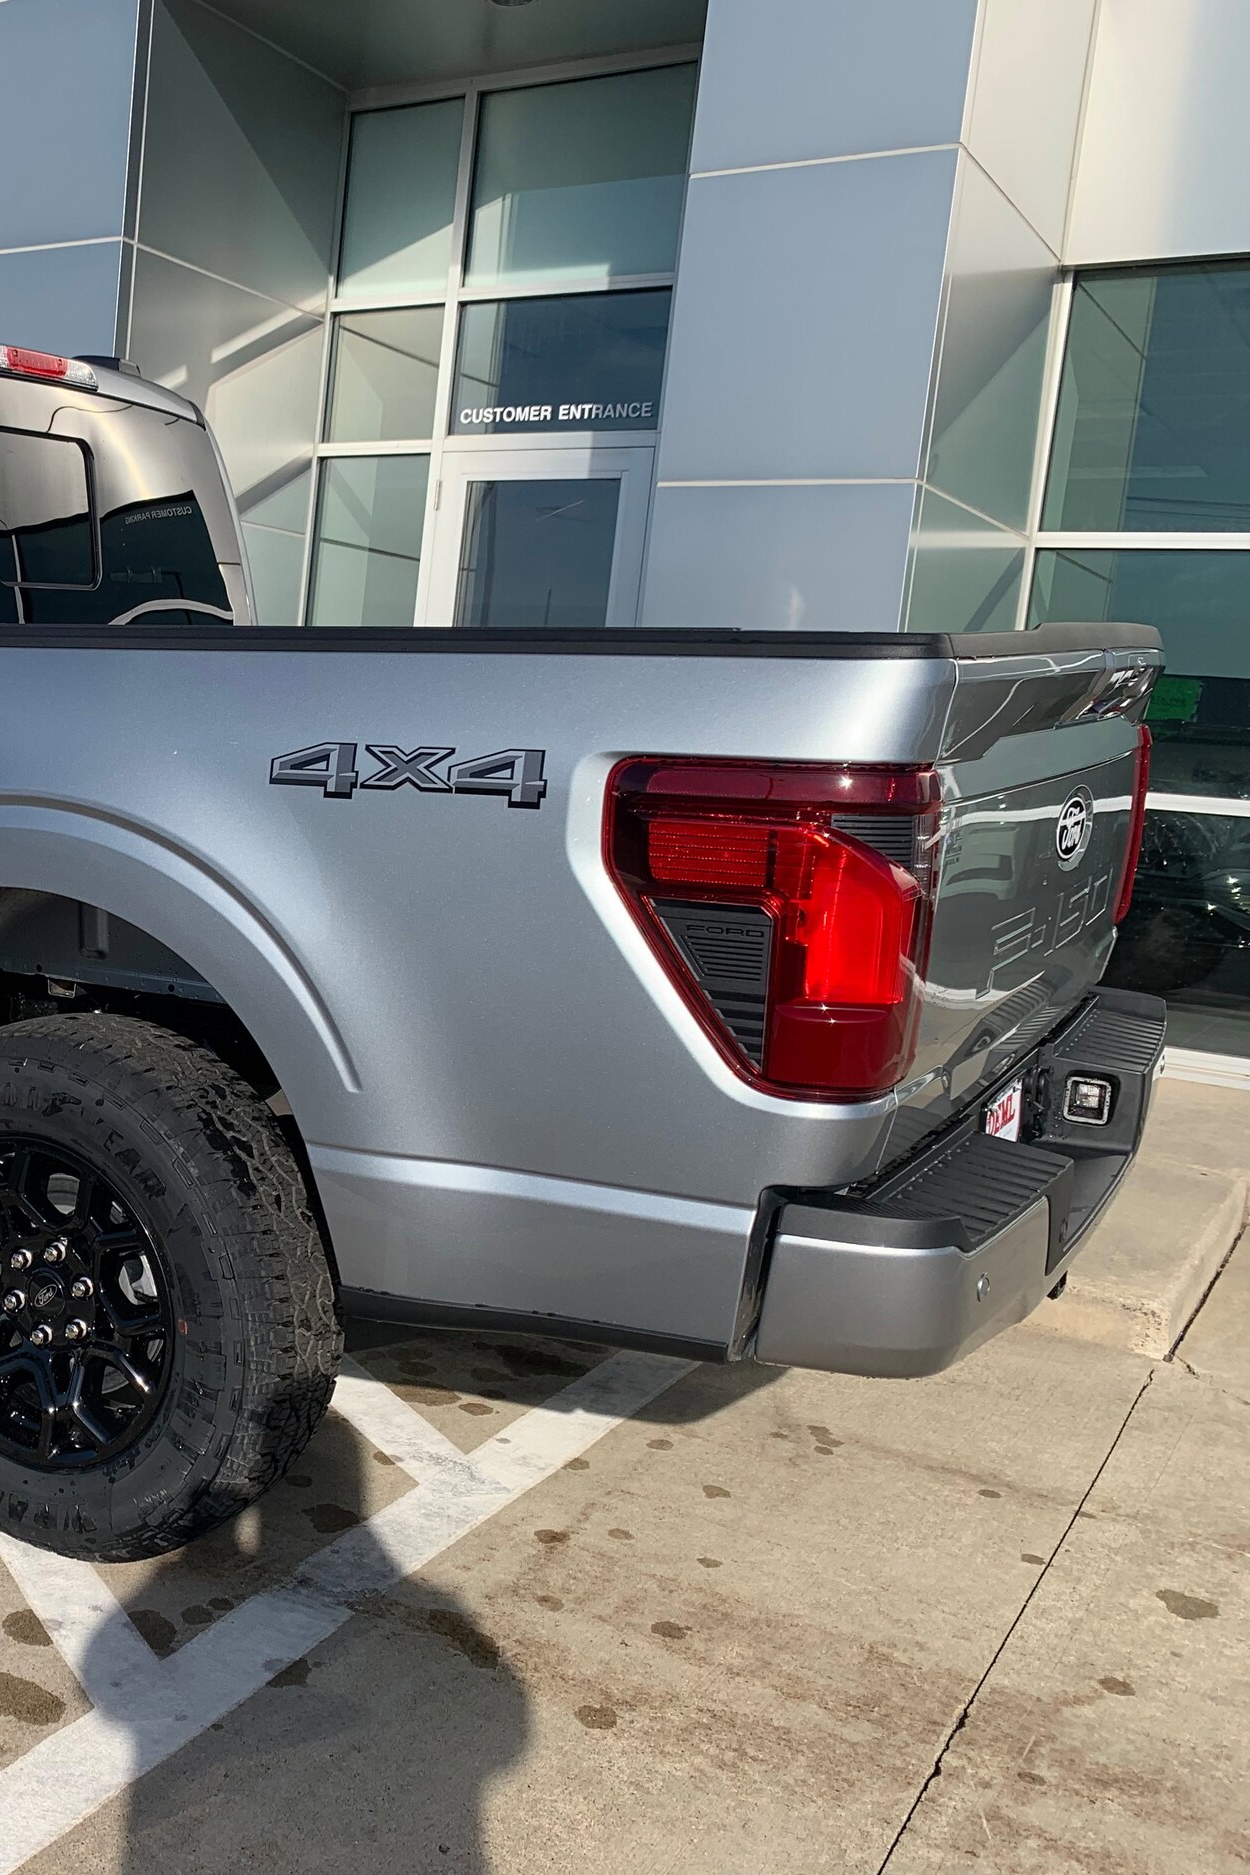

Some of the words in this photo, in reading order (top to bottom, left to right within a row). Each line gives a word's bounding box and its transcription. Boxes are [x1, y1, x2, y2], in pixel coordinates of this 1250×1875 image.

[460, 404, 552, 424] CUSTOMER
[558, 402, 653, 420] ENTRANCE
[686, 924, 765, 938] FORD
